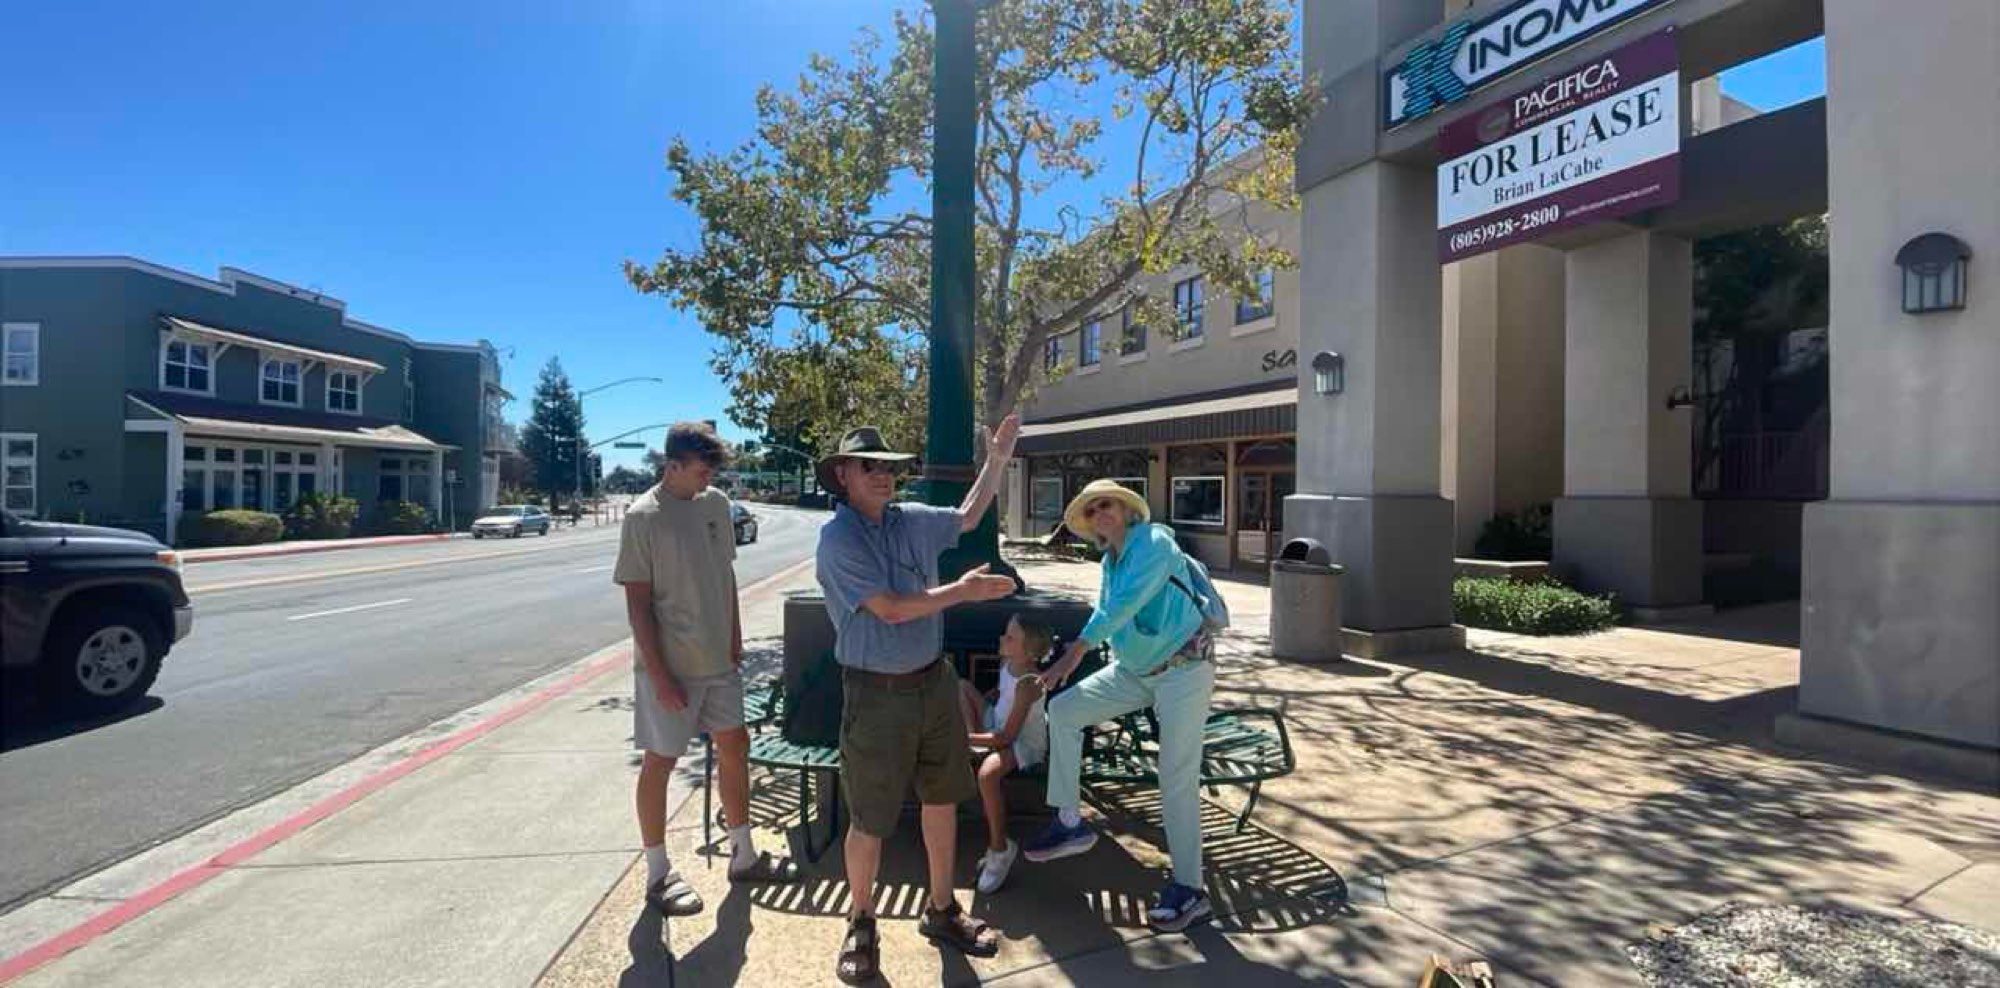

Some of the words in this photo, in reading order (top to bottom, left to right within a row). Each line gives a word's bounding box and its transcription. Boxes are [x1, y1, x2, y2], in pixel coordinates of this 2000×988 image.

[1514, 59, 1619, 118] PACIFICA
[1451, 144, 1518, 195] FOR
[1530, 86, 1663, 166] LEASE
[1493, 180, 1534, 204] Brian
[1539, 155, 1604, 189] LaCabe
[1450, 204, 1560, 252] (805)928-2800
